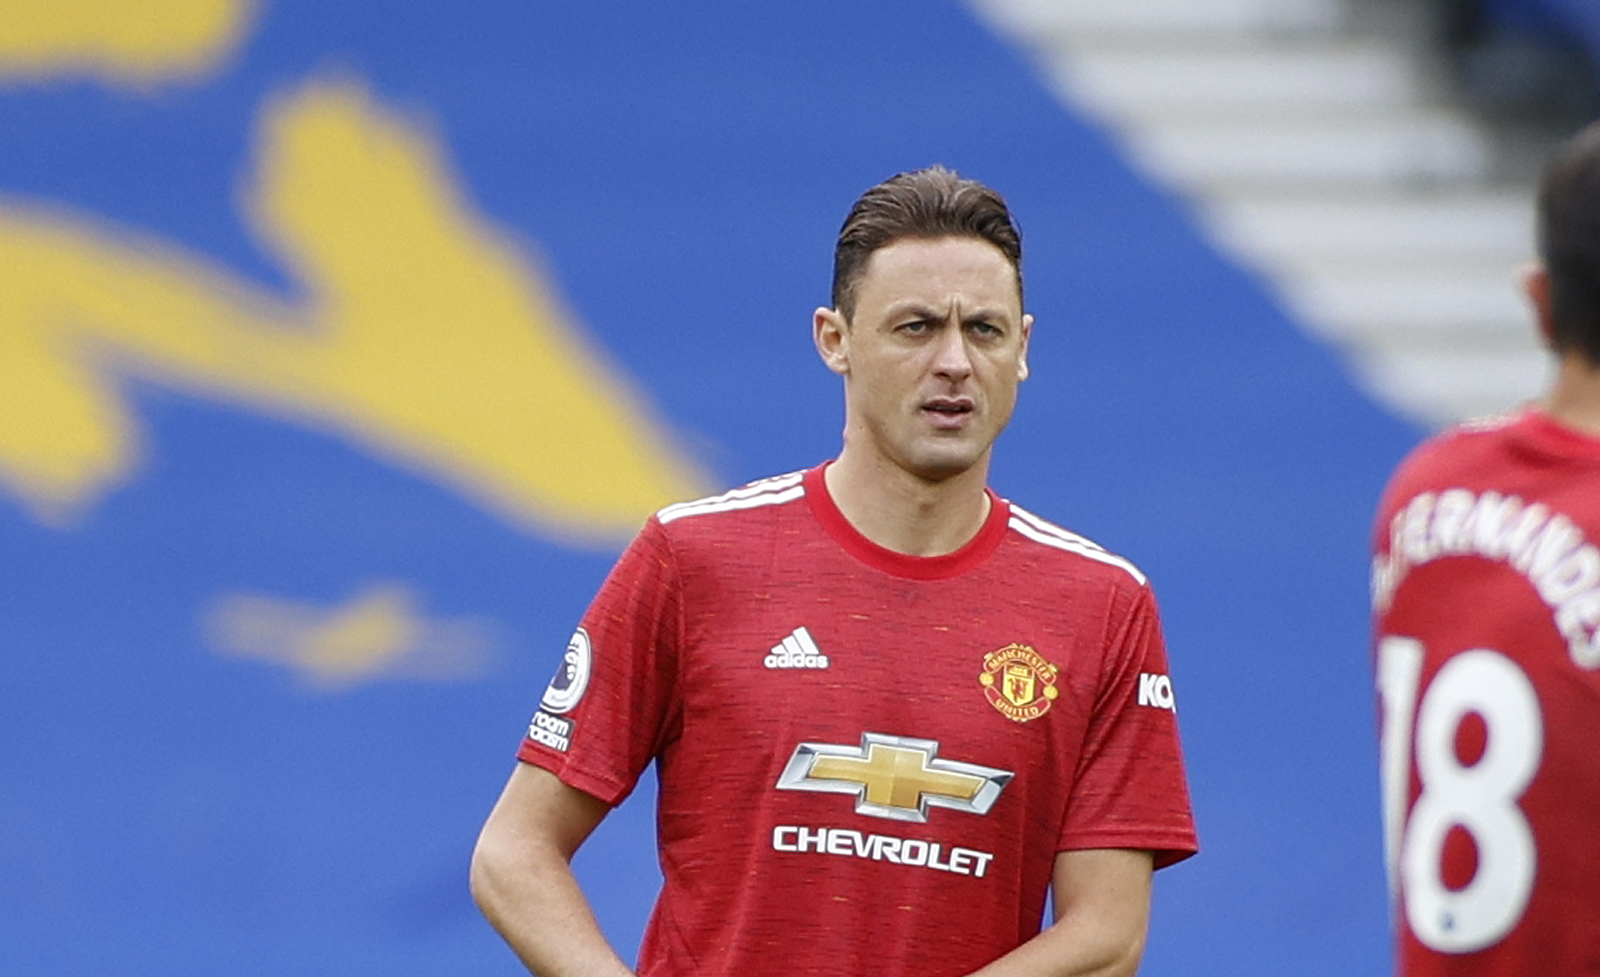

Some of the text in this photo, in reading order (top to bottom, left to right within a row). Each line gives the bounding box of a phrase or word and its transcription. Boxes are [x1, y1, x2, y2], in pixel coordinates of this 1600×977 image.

[763, 651, 830, 669] adidas
[995, 698, 1040, 716] UNITED
[1138, 672, 1177, 714] KO
[1377, 634, 1547, 956] 18
[772, 825, 994, 878] CHEVROLET
